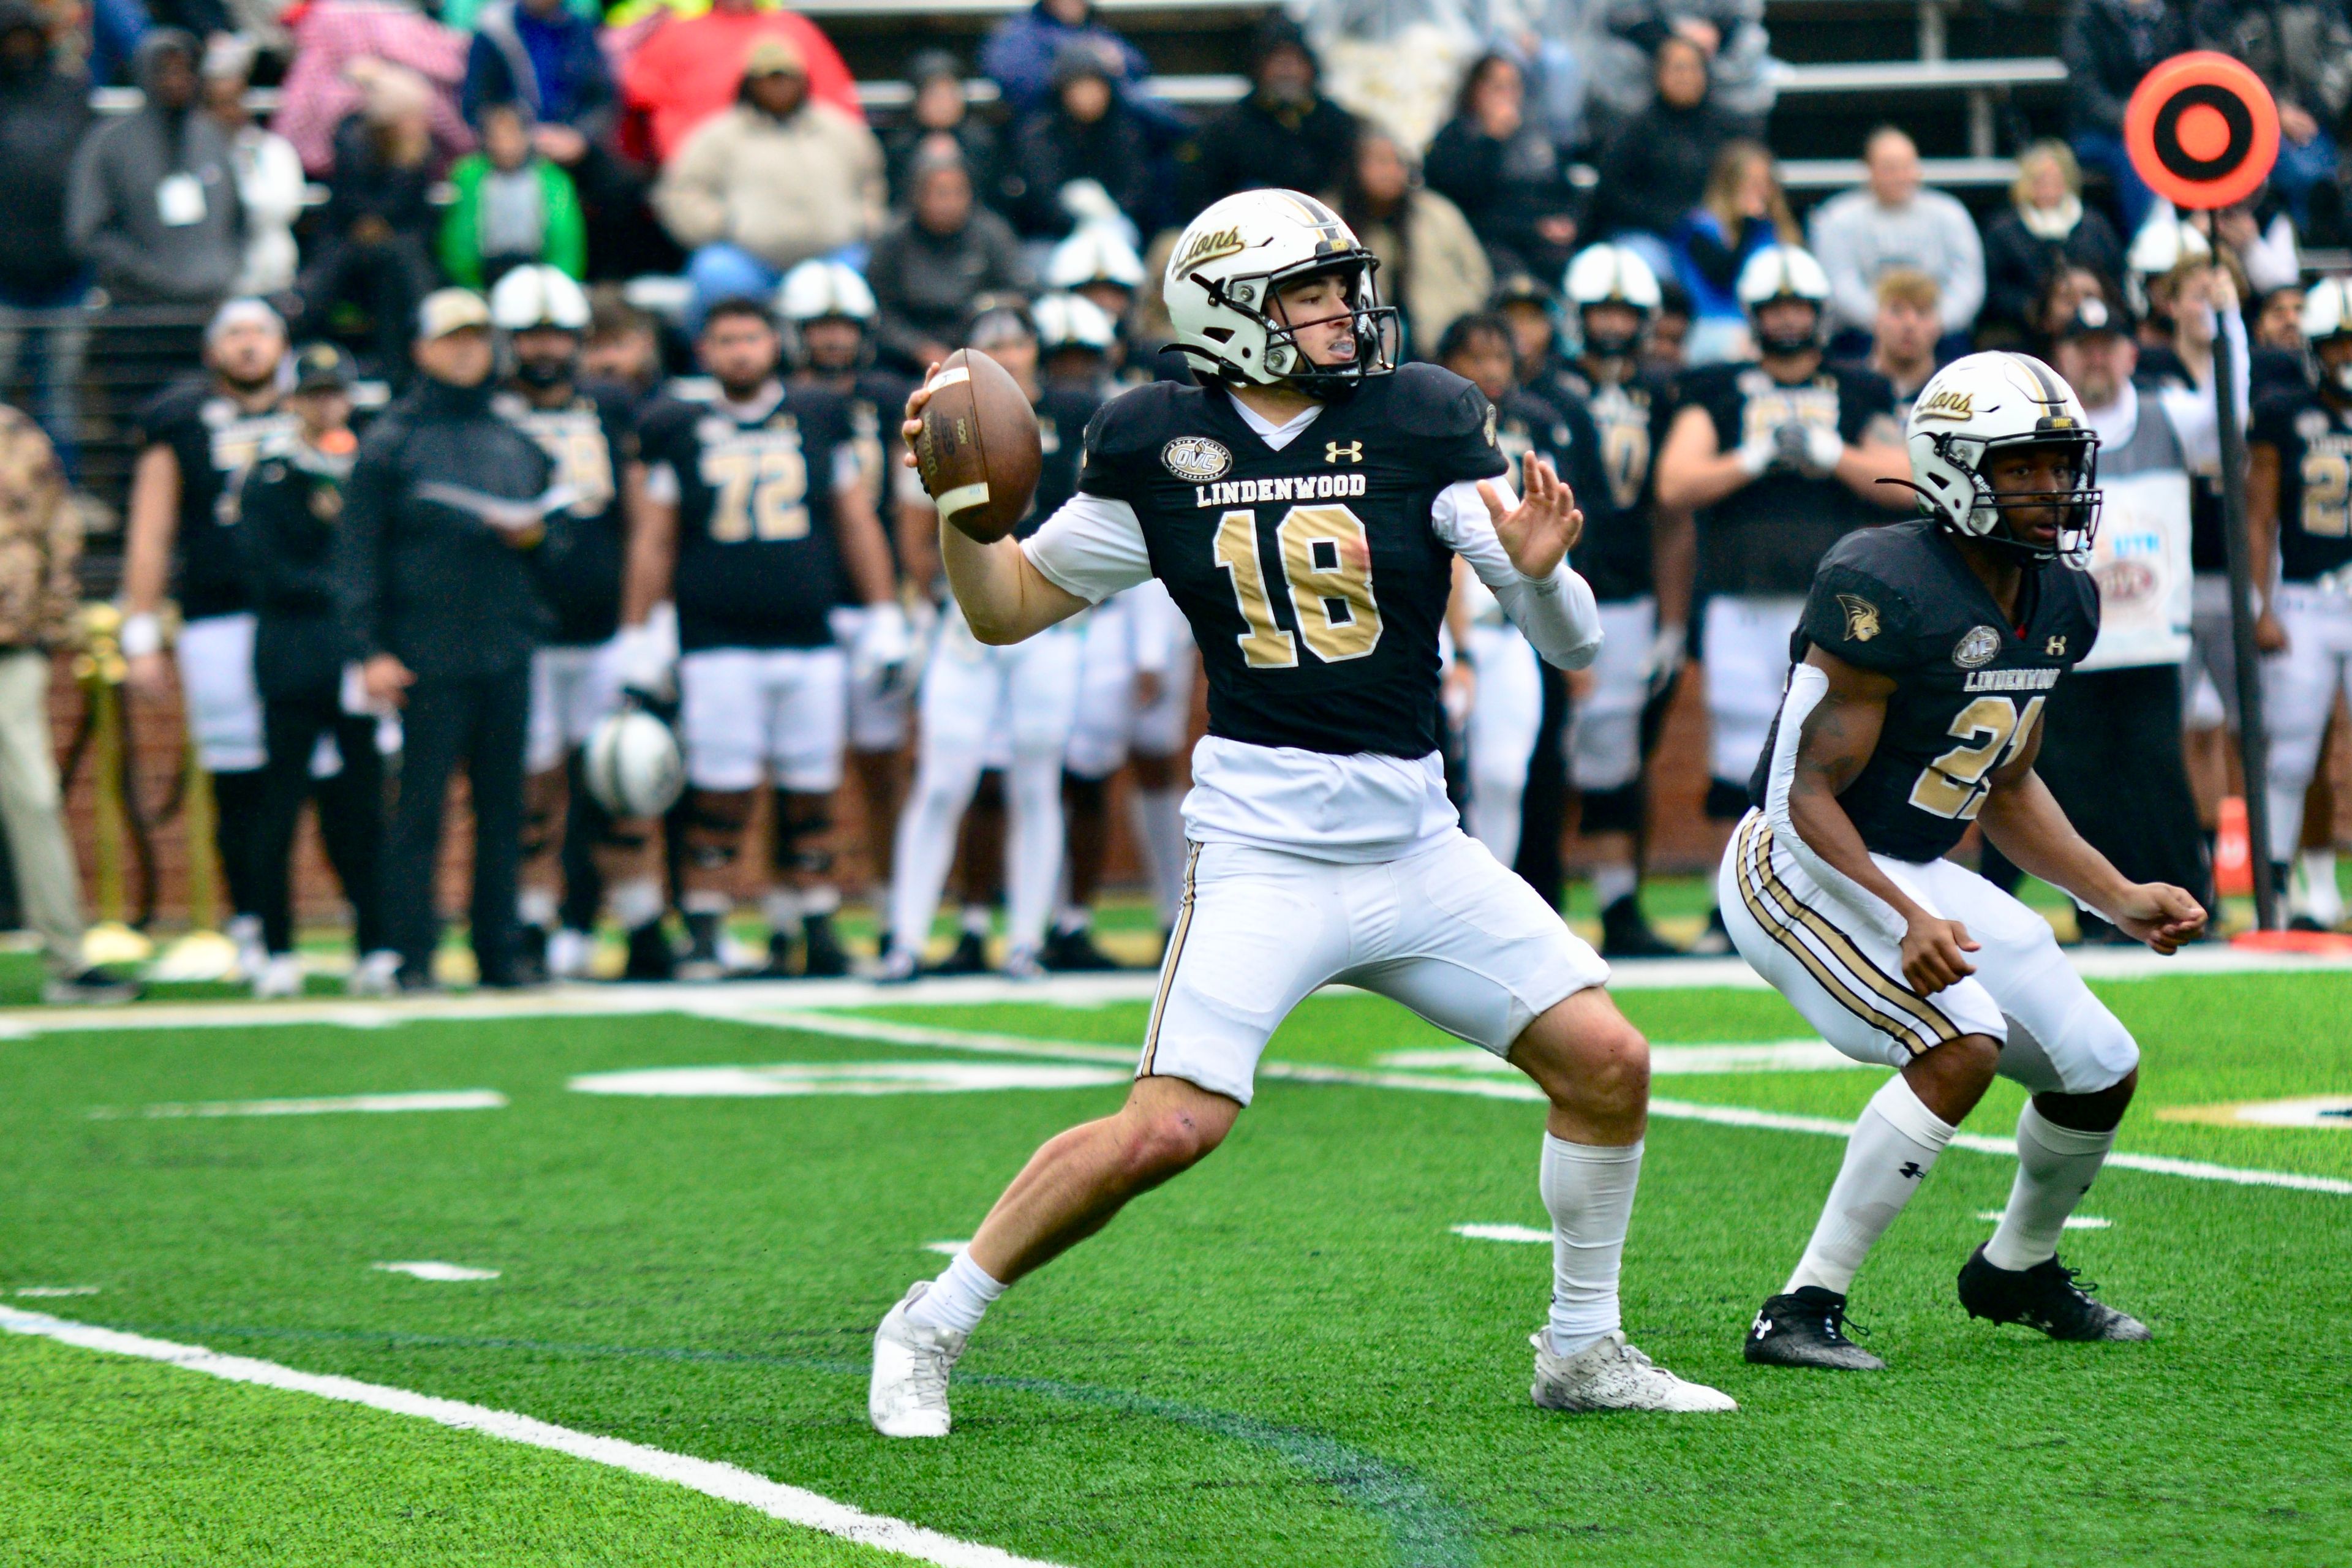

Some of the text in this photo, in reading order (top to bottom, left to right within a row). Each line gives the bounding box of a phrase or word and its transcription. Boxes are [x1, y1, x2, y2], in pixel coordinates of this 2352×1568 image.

[1171, 225, 1245, 282] Lions
[1915, 379, 1973, 424] Lions
[1175, 449, 1218, 471] OVC
[697, 453, 811, 539] 72
[1196, 474, 1366, 508] LINDENWOOD
[1213, 503, 1384, 668] 18
[1907, 696, 2046, 820] 21
